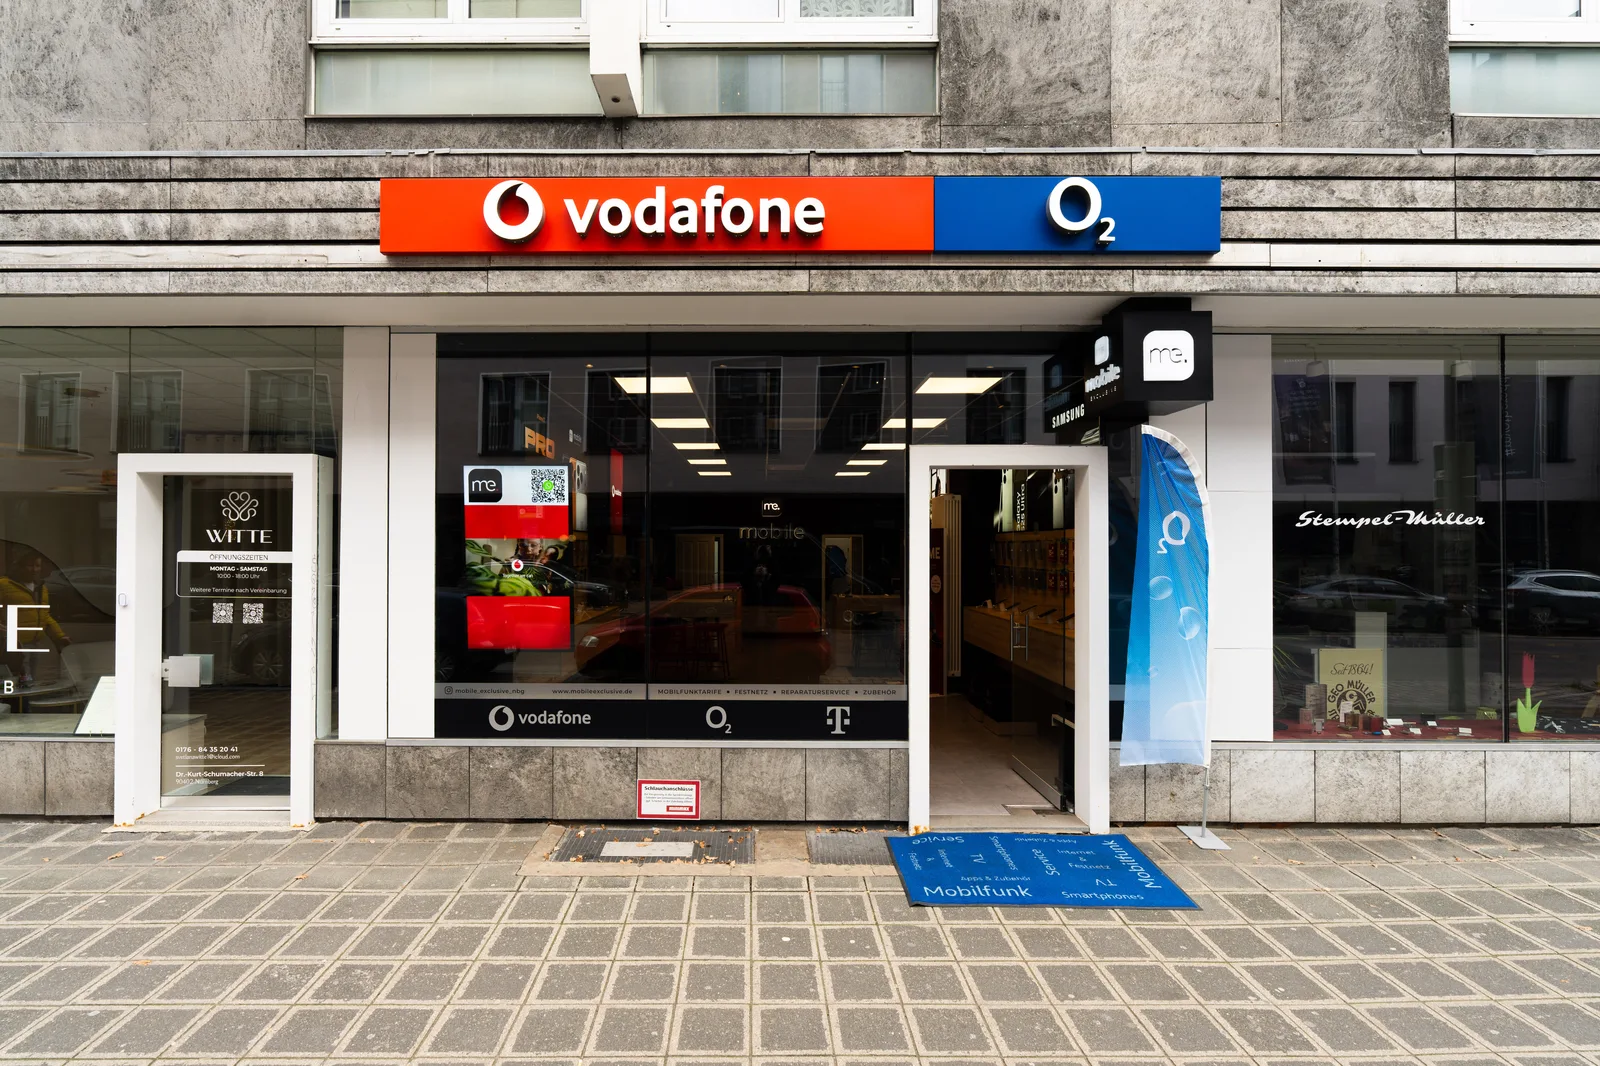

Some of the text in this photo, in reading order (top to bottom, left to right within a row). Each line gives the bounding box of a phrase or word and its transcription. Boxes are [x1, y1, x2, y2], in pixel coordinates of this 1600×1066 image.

[564, 185, 825, 236] vodafone
[1150, 347, 1188, 364] me.
[1085, 363, 1121, 393] mobile
[1051, 403, 1085, 429] SAMSUNG
[525, 426, 555, 459] PRO
[763, 502, 781, 511] me.
[1295, 510, 1485, 529] Stempel-Müller
[206, 529, 273, 544] WITTE
[740, 523, 805, 540] mobile
[209, 553, 269, 561] ÖFFNUNGSZEITEN
[250, 587, 288, 595] Vereinbarung
[0, 605, 50, 653] E
[455, 687, 525, 695] mobile_exclusive_nbg
[863, 688, 897, 696] ZUBEHÖR
[1327, 683, 1345, 703] GEO
[1347, 680, 1376, 704] MÜLLER
[517, 710, 592, 725] vodafone
[912, 836, 965, 845] Service
[1032, 848, 1061, 876] Service
[1068, 862, 1111, 870] Festnetz
[1101, 839, 1162, 889] Mobilfunk
[1095, 878, 1118, 887] TV
[923, 885, 1033, 897] Mobilfunk
[1062, 891, 1144, 901] Smartphones
